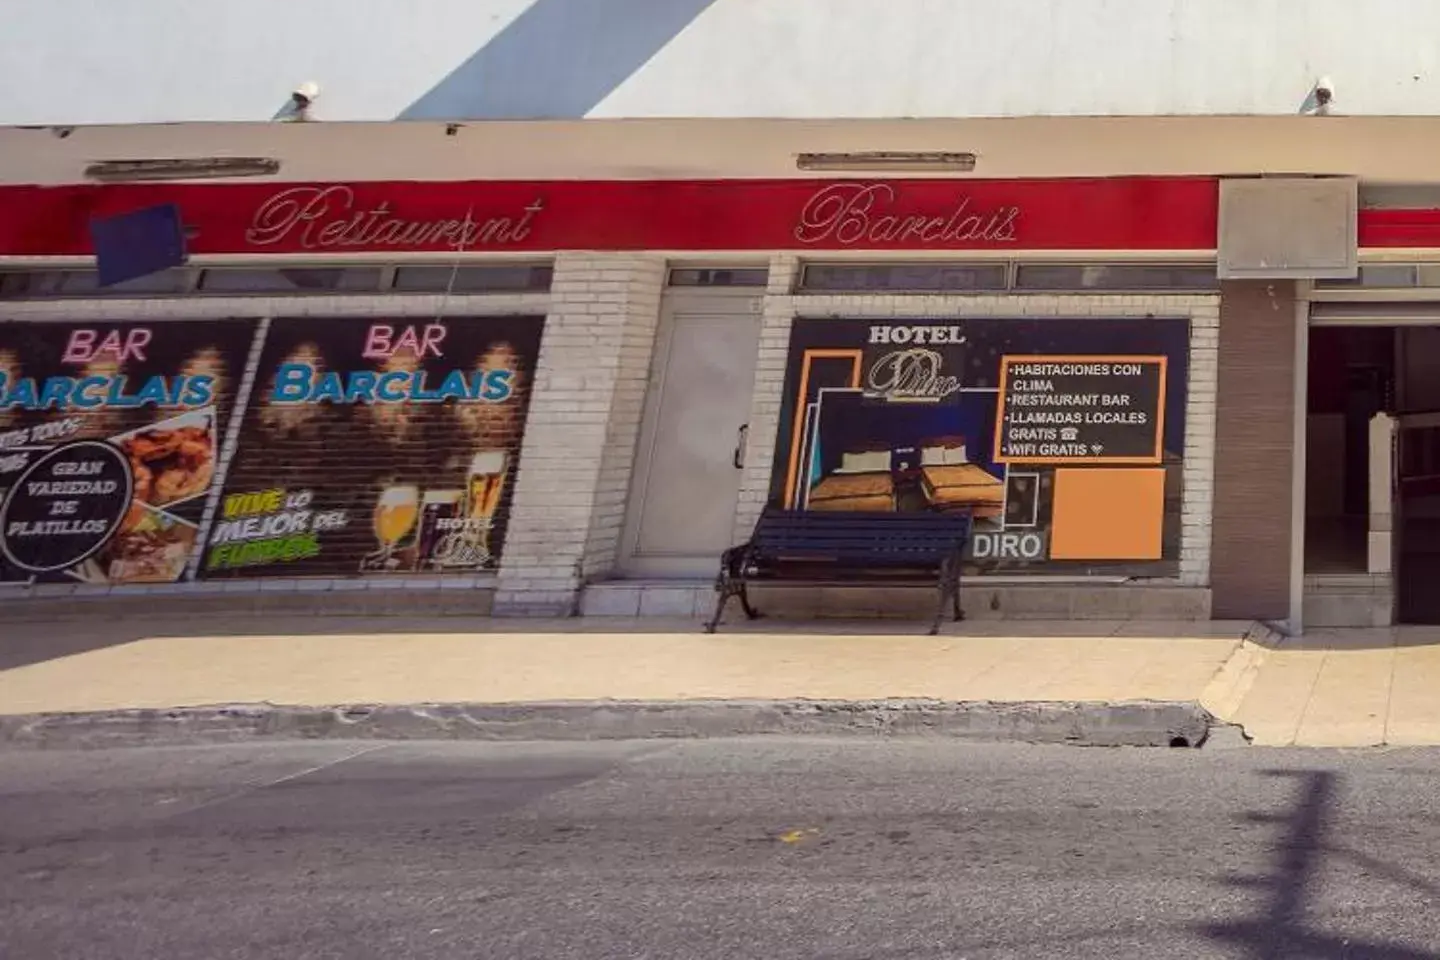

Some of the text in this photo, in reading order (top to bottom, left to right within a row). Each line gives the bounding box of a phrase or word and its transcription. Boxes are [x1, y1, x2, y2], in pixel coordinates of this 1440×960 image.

[796, 183, 1018, 243] Barclais
[362, 325, 446, 358] BAR
[868, 326, 967, 344] HOTEL
[61, 329, 152, 363] BAR
[1014, 364, 1142, 376] HABITACIONES CON
[270, 363, 516, 405] BARCLAIS
[1013, 379, 1054, 391] CLIMA
[1011, 394, 1130, 406] RESTAURANT BAR
[1010, 412, 1147, 424] LLAMADAS LOCALES
[1009, 428, 1057, 440] GRATIS
[1008, 443, 1087, 455] WIFI GRATIS
[52, 462, 104, 476] GRAN
[28, 482, 118, 496] VARIEDAD
[49, 500, 80, 515] DE
[7, 520, 108, 537] PLATILLOS
[211, 510, 348, 543] MEJOR DEL
[973, 534, 1041, 558] DIRO
